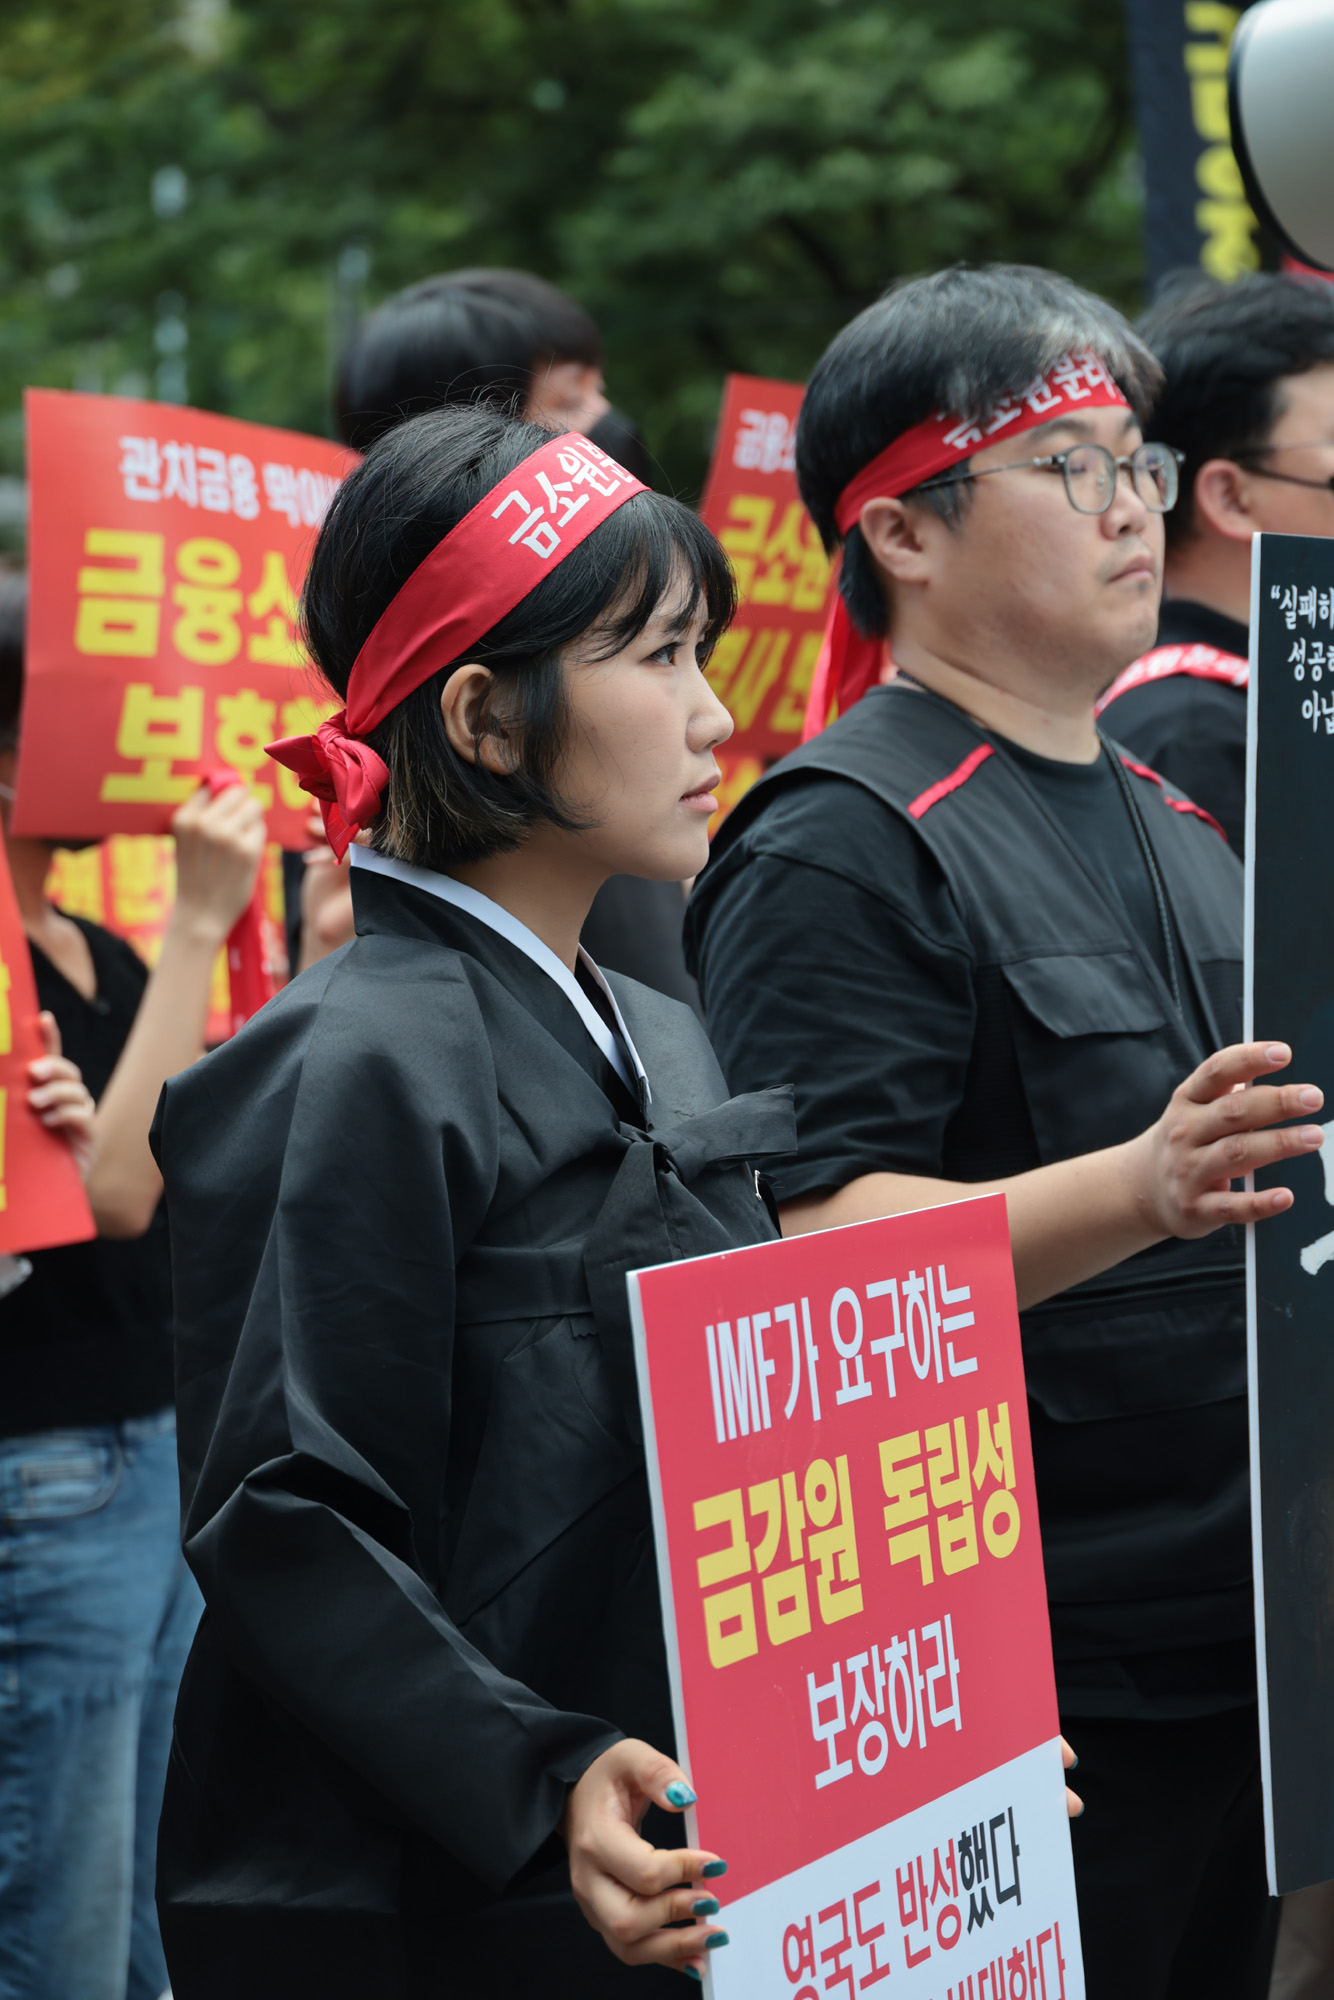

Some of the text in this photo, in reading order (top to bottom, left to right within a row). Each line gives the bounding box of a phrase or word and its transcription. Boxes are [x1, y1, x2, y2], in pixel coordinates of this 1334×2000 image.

[119, 434, 260, 521] 관치금융
[705, 1264, 978, 1444] IMF가 요구하는
[693, 1401, 1021, 1669] 금감원 독립성
[806, 1613, 963, 1790] 보장하라
[782, 1806, 1021, 2000] 영국도 반성했다
